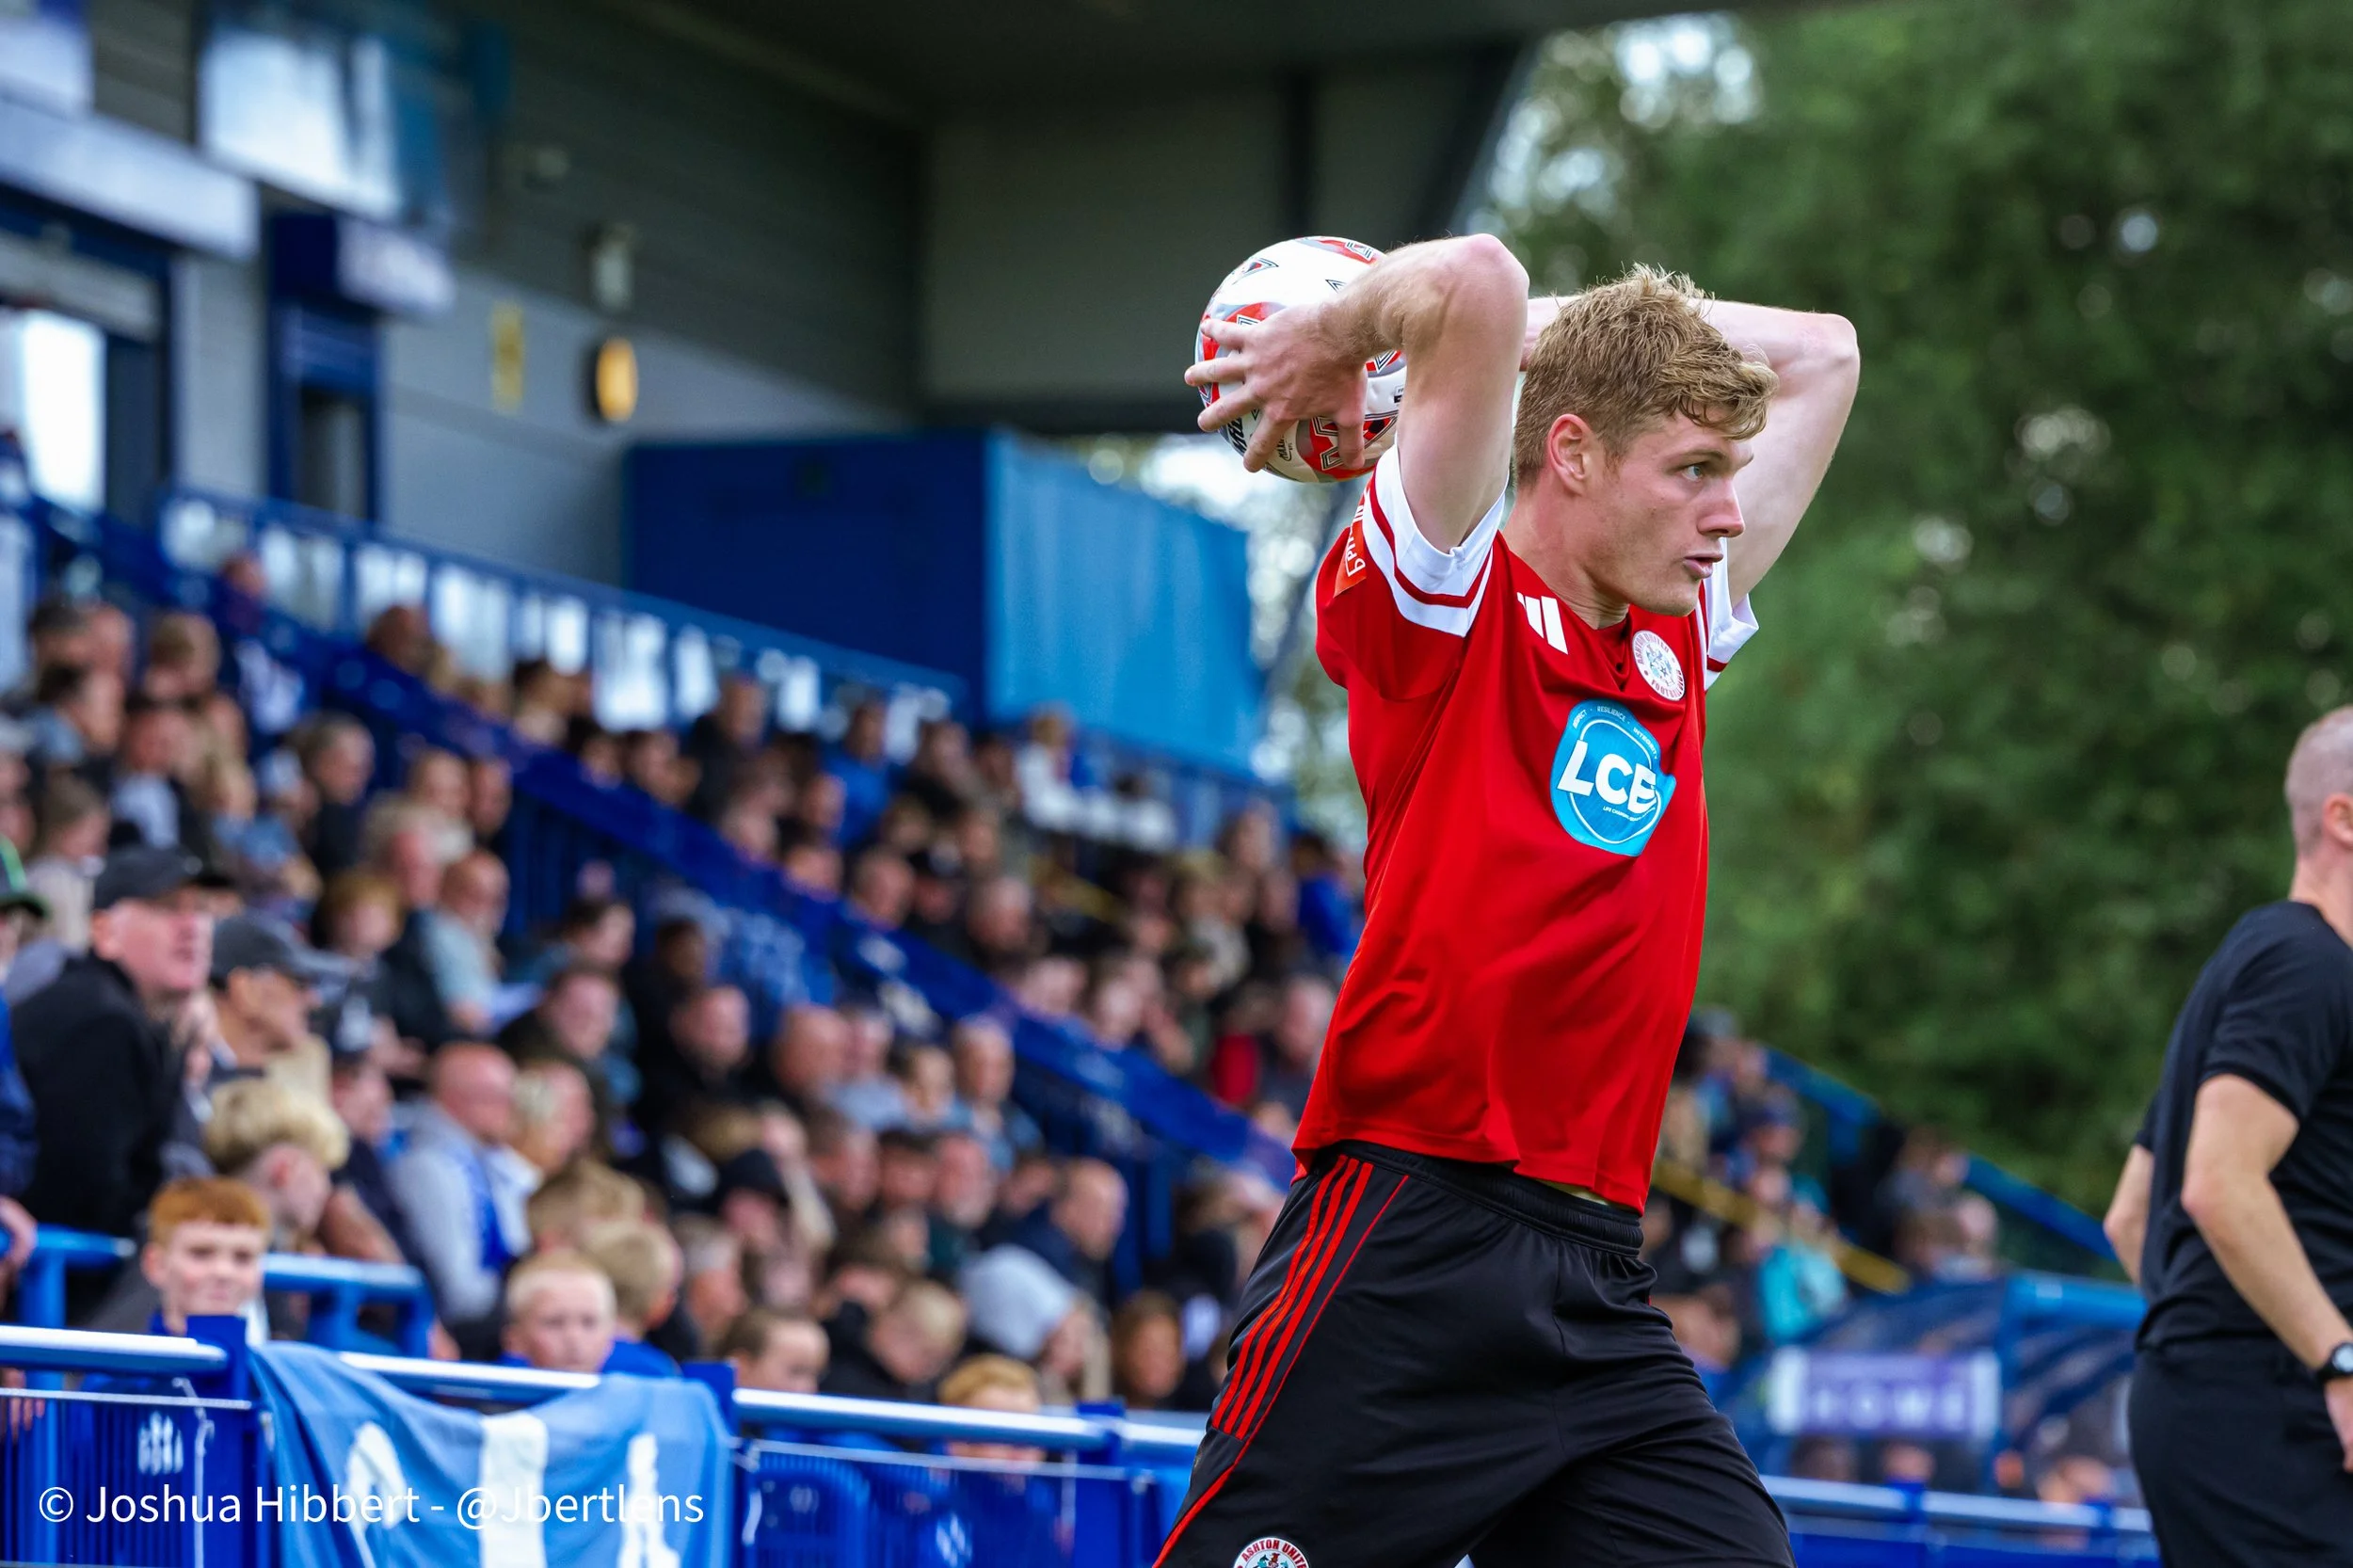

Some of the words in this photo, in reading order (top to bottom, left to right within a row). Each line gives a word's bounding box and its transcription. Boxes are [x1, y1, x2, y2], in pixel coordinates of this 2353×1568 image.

[1557, 740, 1657, 813] LCE
[1241, 1539, 1280, 1562] ASHTON
[1282, 1542, 1307, 1568] UNITE
